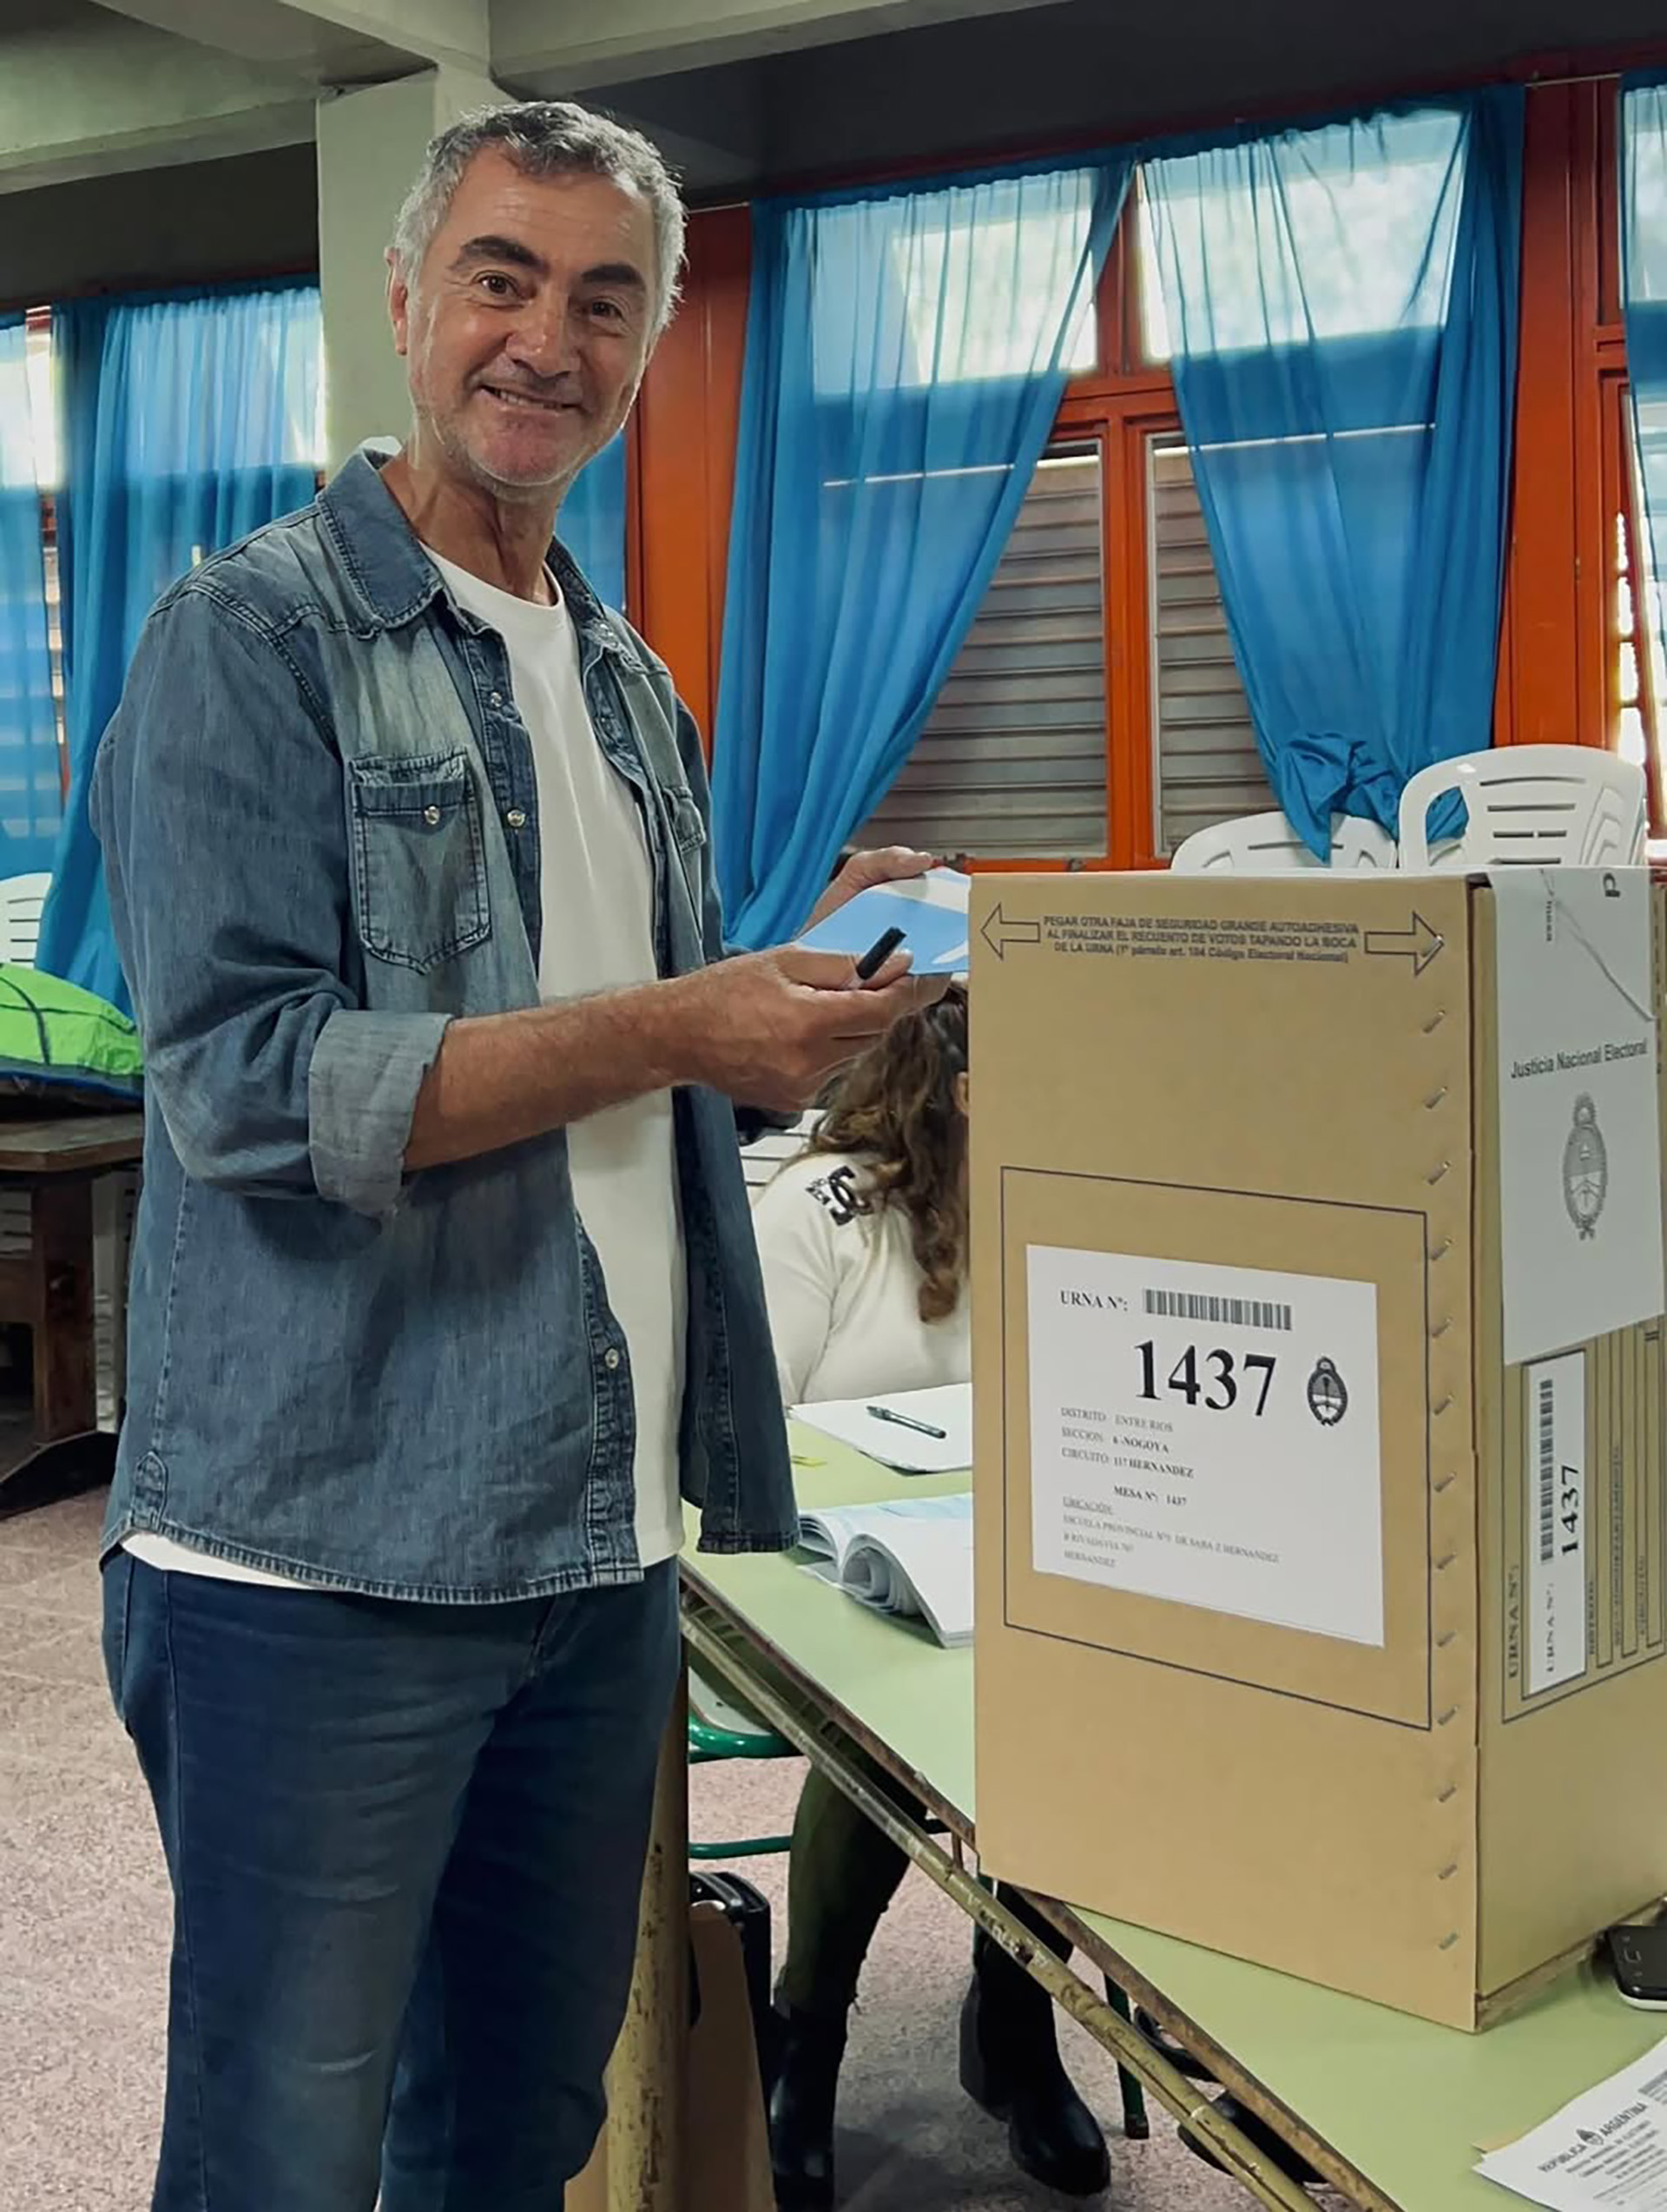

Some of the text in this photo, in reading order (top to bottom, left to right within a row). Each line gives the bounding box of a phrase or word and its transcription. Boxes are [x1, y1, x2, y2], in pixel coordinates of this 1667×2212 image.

[1044, 916, 1360, 934] PEGAR OTRA FAJA DE SEGURIDAD GRANDE AUTOADHESIVA
[1047, 929, 1357, 948] AL FINALIZAR EL RECUENTO DE VOTOS TAPANDO LA BOCA
[1054, 942, 1068, 951] DE
[1070, 943, 1084, 952] LA
[1085, 943, 1114, 954] URNA
[1511, 1037, 1648, 1078] Justicia Nacional Electoral
[1060, 1289, 1103, 1308] URNA
[1134, 1339, 1278, 1418] 1437
[1115, 1414, 1145, 1428] ENTRE
[1149, 1419, 1174, 1432] RIOS
[1129, 1458, 1195, 1478] HERNANDEZ
[1114, 1485, 1143, 1500] MESA
[1166, 1494, 1187, 1506] 1437
[1561, 1464, 1579, 1556] 1437
